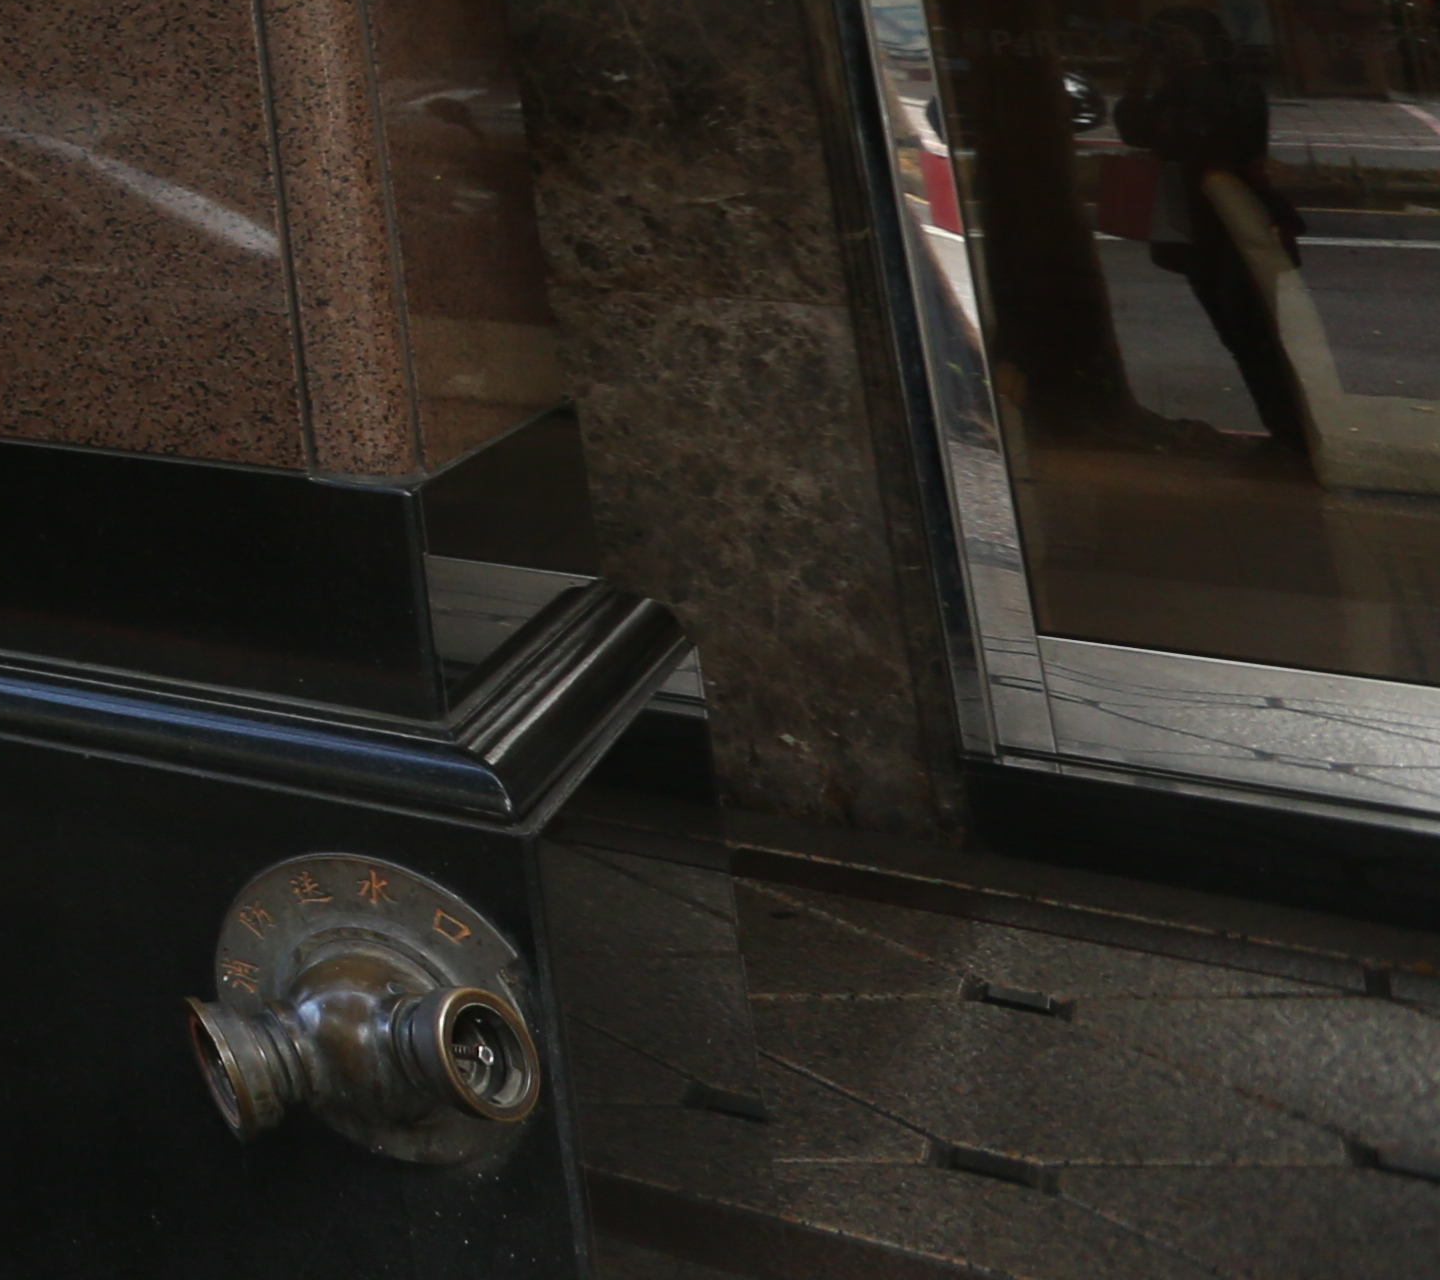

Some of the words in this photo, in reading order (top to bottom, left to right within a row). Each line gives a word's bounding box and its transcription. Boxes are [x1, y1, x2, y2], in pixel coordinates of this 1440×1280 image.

[221, 870, 473, 994] 消防送水口
